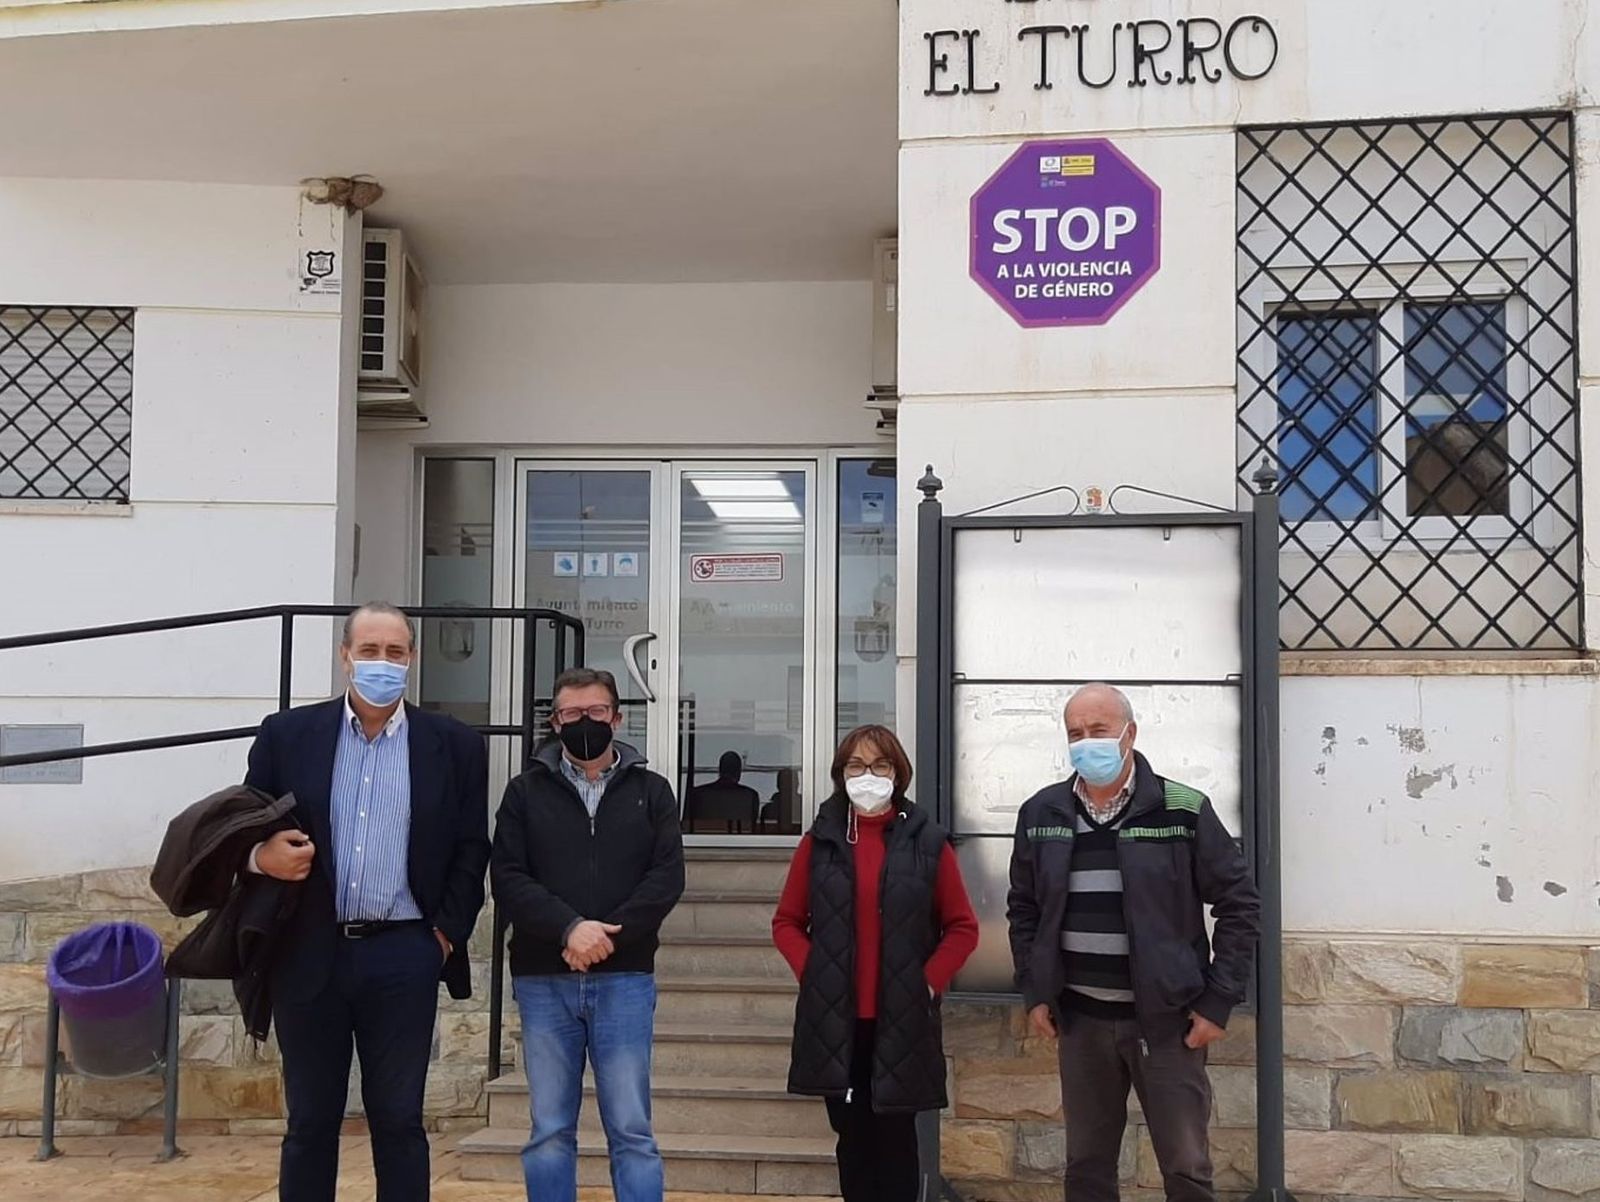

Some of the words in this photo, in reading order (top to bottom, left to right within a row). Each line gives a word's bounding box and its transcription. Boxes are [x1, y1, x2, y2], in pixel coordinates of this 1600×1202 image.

[924, 29, 1000, 97] EL
[1018, 15, 1279, 90] TURRO
[992, 206, 1138, 254] STOP
[996, 264, 1009, 279] A
[1013, 263, 1035, 278] LA
[1038, 260, 1132, 278] VIOLENCIA
[1014, 284, 1038, 299] DE
[1042, 280, 1114, 298] GÉNERO
